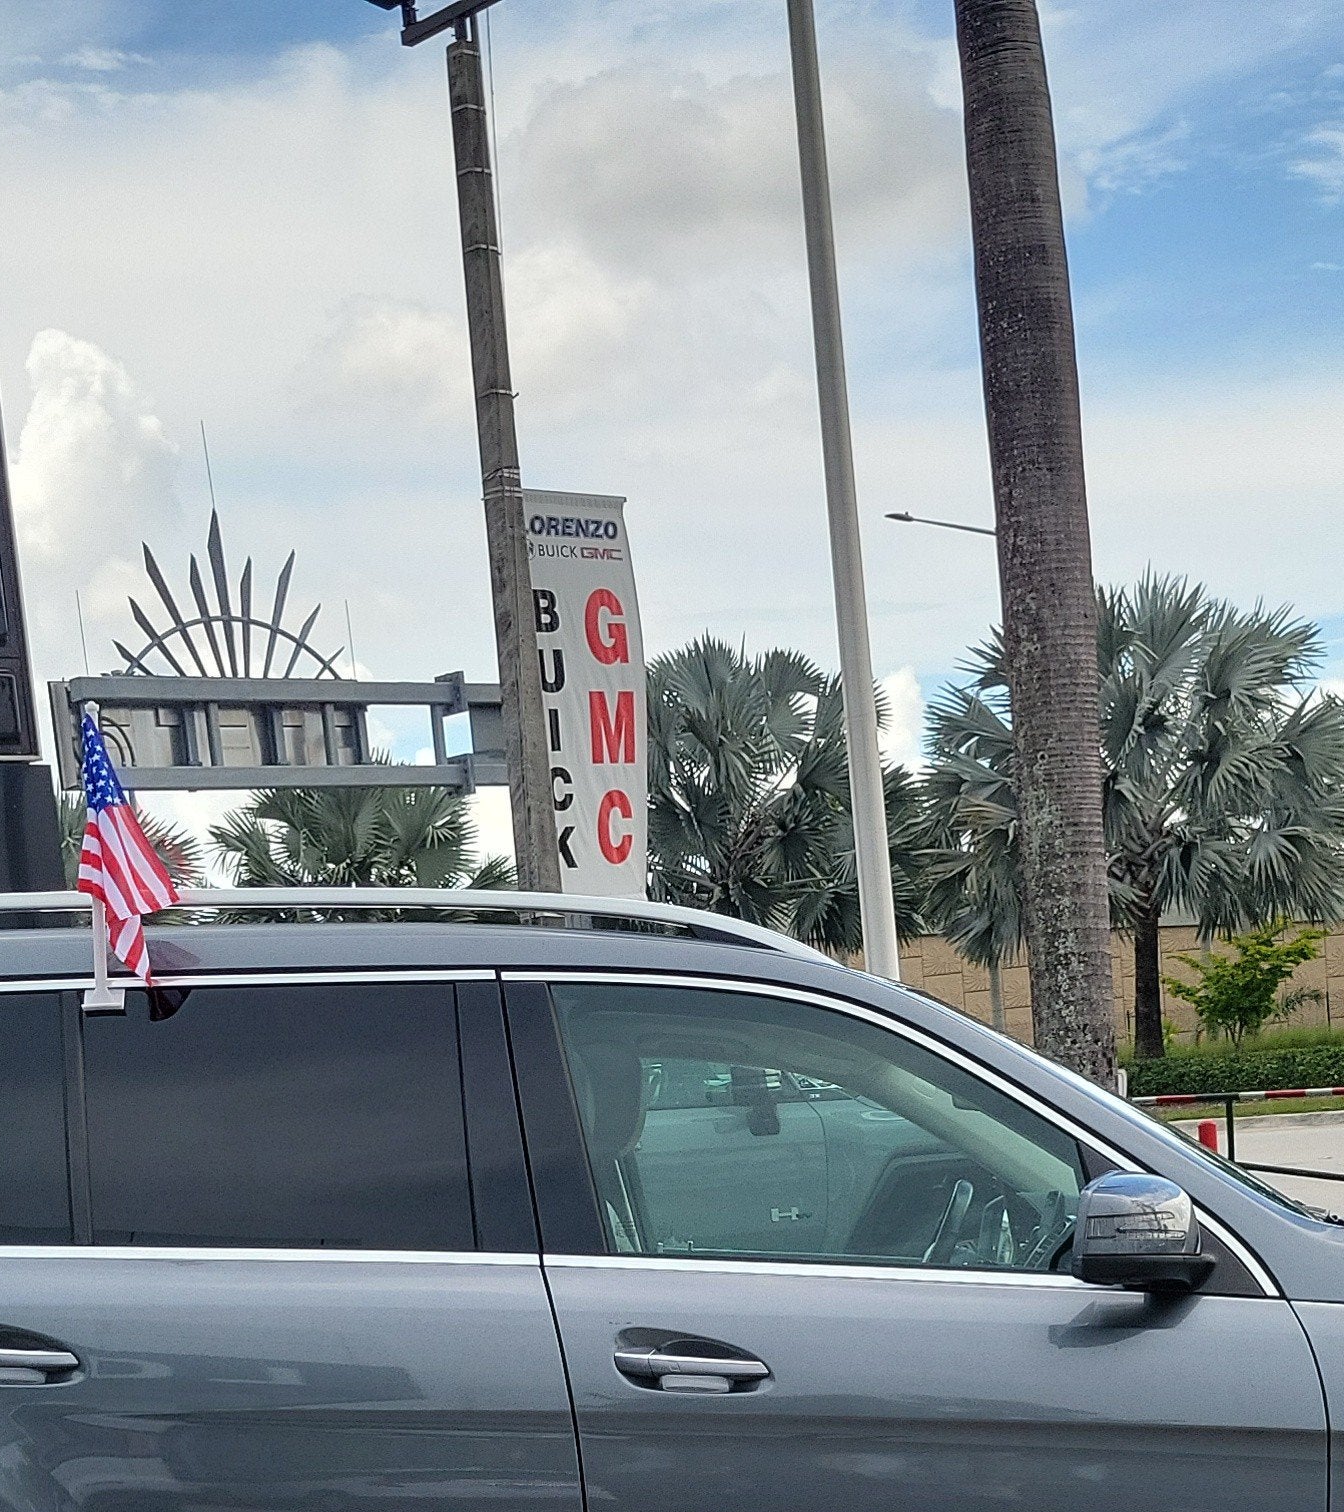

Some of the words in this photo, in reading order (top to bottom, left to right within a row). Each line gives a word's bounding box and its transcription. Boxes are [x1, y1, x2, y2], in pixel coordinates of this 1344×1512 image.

[525, 514, 618, 539] ORENZO
[538, 544, 578, 558] BUICK
[580, 547, 623, 561] GMC
[585, 588, 636, 865] GMC
